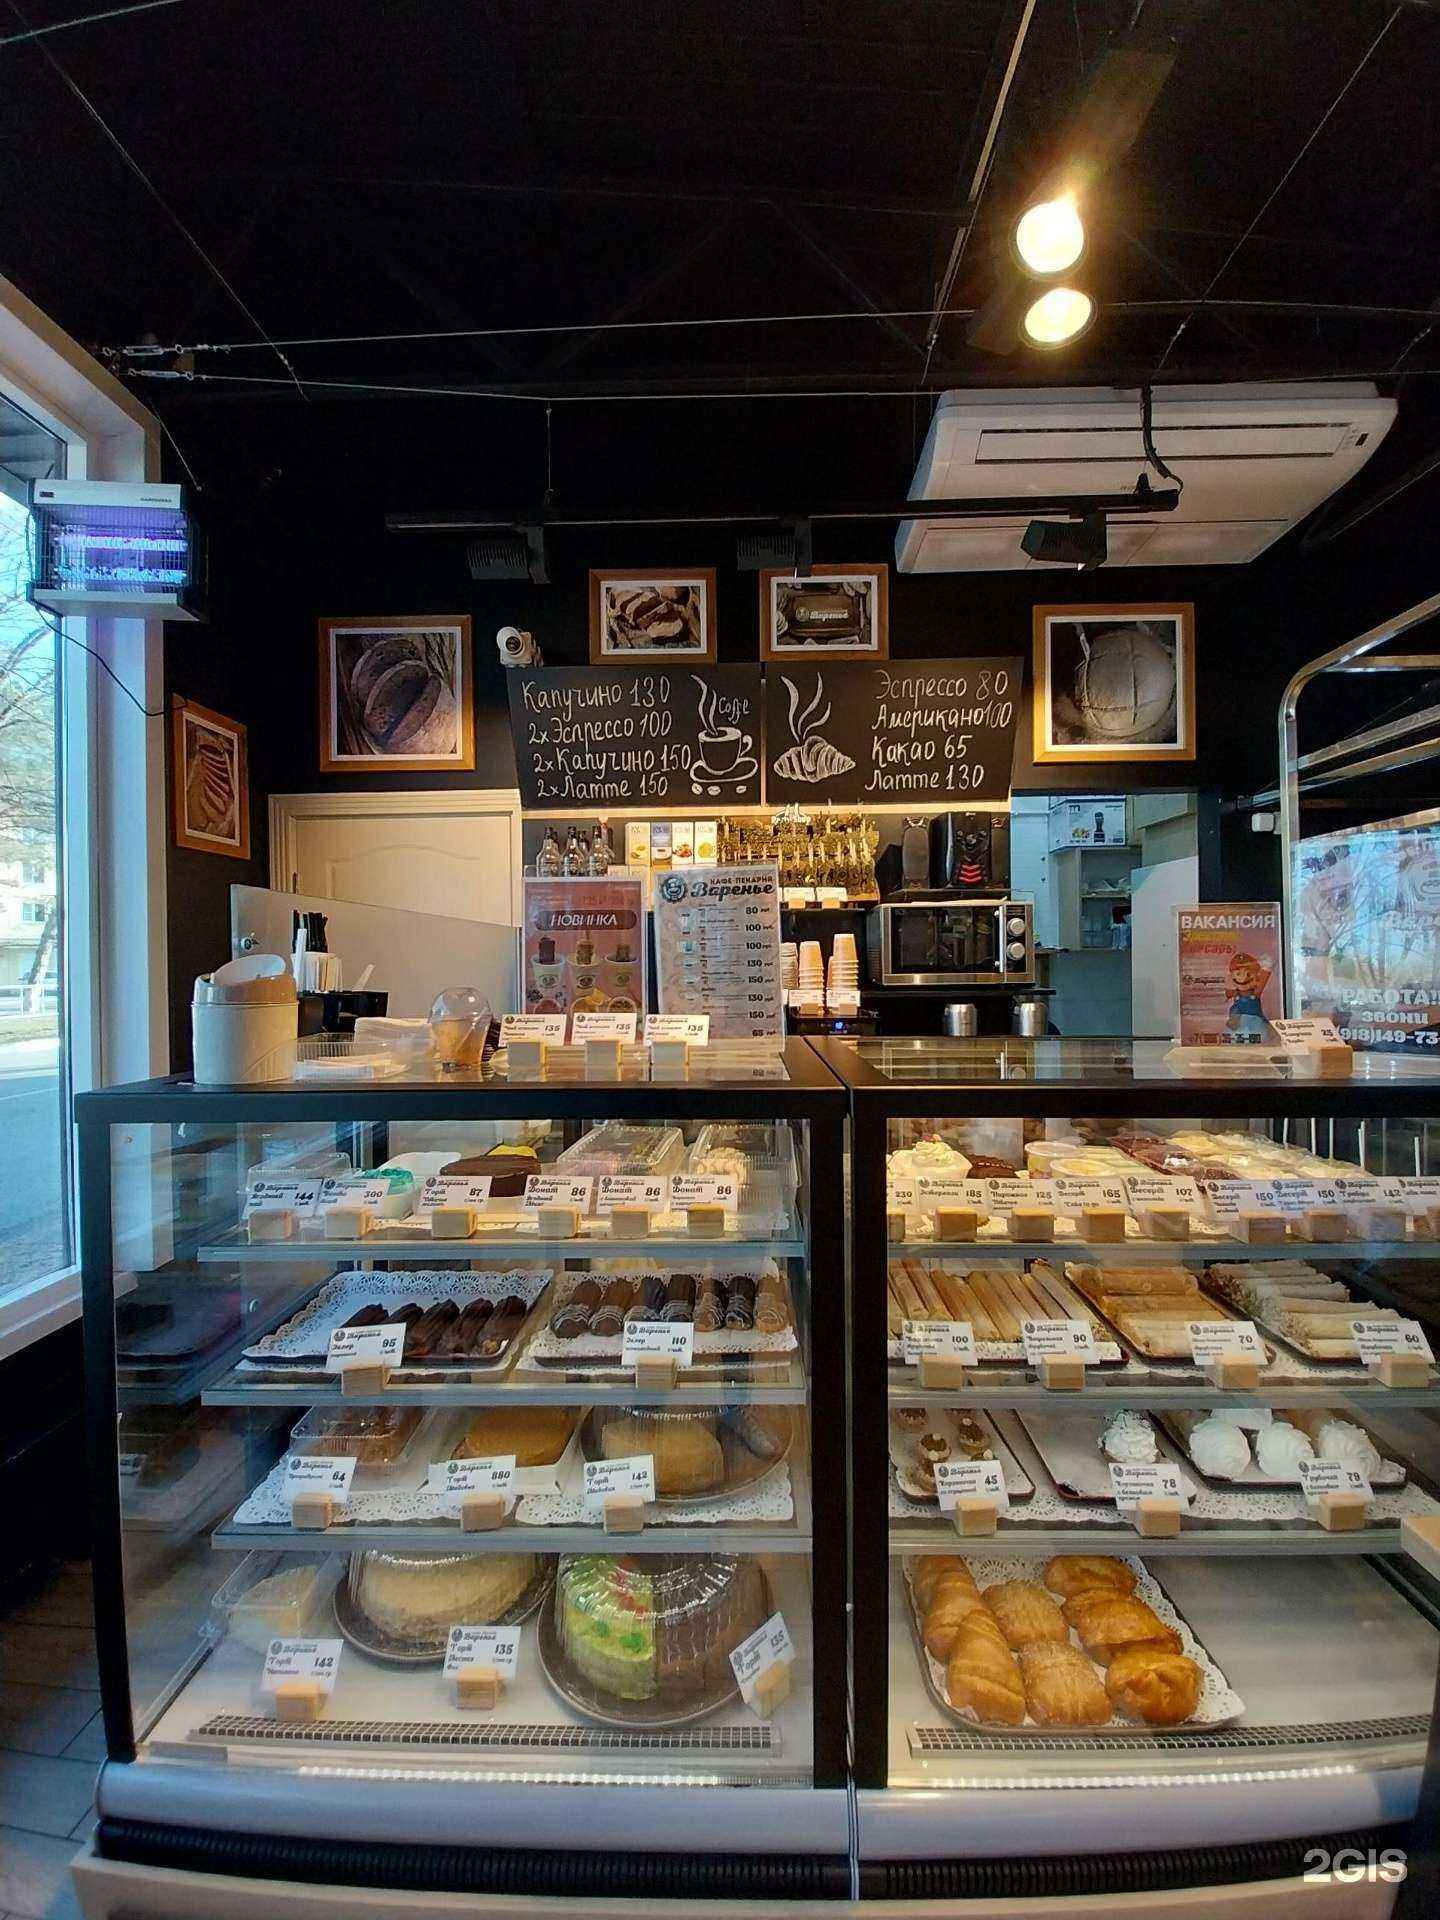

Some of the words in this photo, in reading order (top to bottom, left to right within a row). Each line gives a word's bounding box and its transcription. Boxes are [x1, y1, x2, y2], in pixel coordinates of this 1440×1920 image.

[876, 669, 967, 708] Эспрессо
[976, 670, 1008, 700] 80
[521, 680, 623, 722] Капучино
[629, 676, 670, 707] 130
[871, 703, 984, 737] Американо
[984, 701, 1013, 728] 100
[551, 716, 634, 750] Эспрессо
[638, 710, 672, 738] 100
[871, 735, 936, 767] Какао
[944, 734, 974, 759] 65
[556, 746, 655, 779] Капучино
[659, 744, 691, 771] 150
[864, 768, 940, 791] Латте
[945, 763, 985, 790] 130
[560, 775, 632, 799] Латте
[639, 771, 669, 797] 150
[690, 880, 775, 901] Варенье
[550, 913, 619, 927] НОВИНКА
[1181, 915, 1275, 929] ВАКАНСИЯ
[745, 923, 761, 932] 100
[745, 941, 762, 950] 100
[571, 1187, 586, 1197] 86
[645, 1187, 661, 1197] 86
[716, 1185, 732, 1195] 86
[671, 1336, 687, 1345] 110
[952, 1335, 969, 1344] 100
[984, 1474, 998, 1486] 45
[1162, 1478, 1177, 1489] 78
